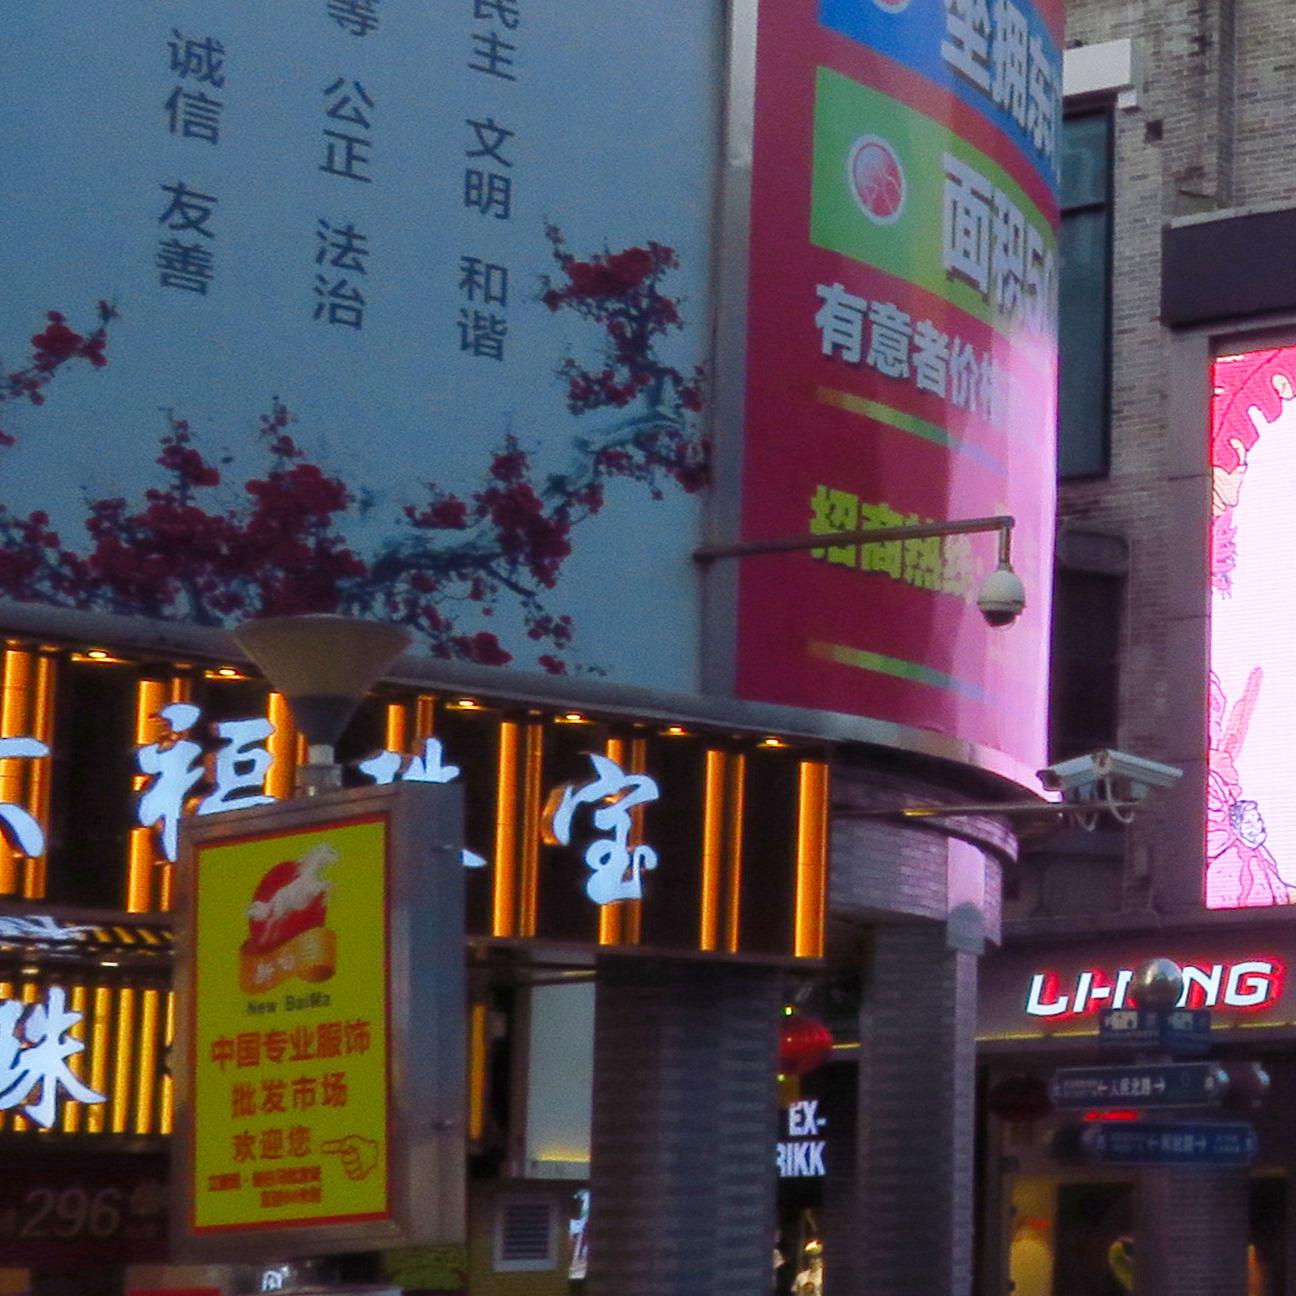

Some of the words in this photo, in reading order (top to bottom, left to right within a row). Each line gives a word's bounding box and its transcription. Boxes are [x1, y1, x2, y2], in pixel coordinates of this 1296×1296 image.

[164, 28, 226, 145] 诚信
[319, 76, 375, 183] 公正
[463, 117, 514, 220] 文明
[155, 180, 219, 296] 友善
[311, 218, 369, 331] 法治
[456, 255, 508, 361] 和谐
[1026, 960, 1276, 1017] LI-NG
[210, 1019, 372, 1070] 中国专业服饰
[230, 1071, 349, 1119] 批发市场
[231, 1124, 313, 1163] 欢迎您
